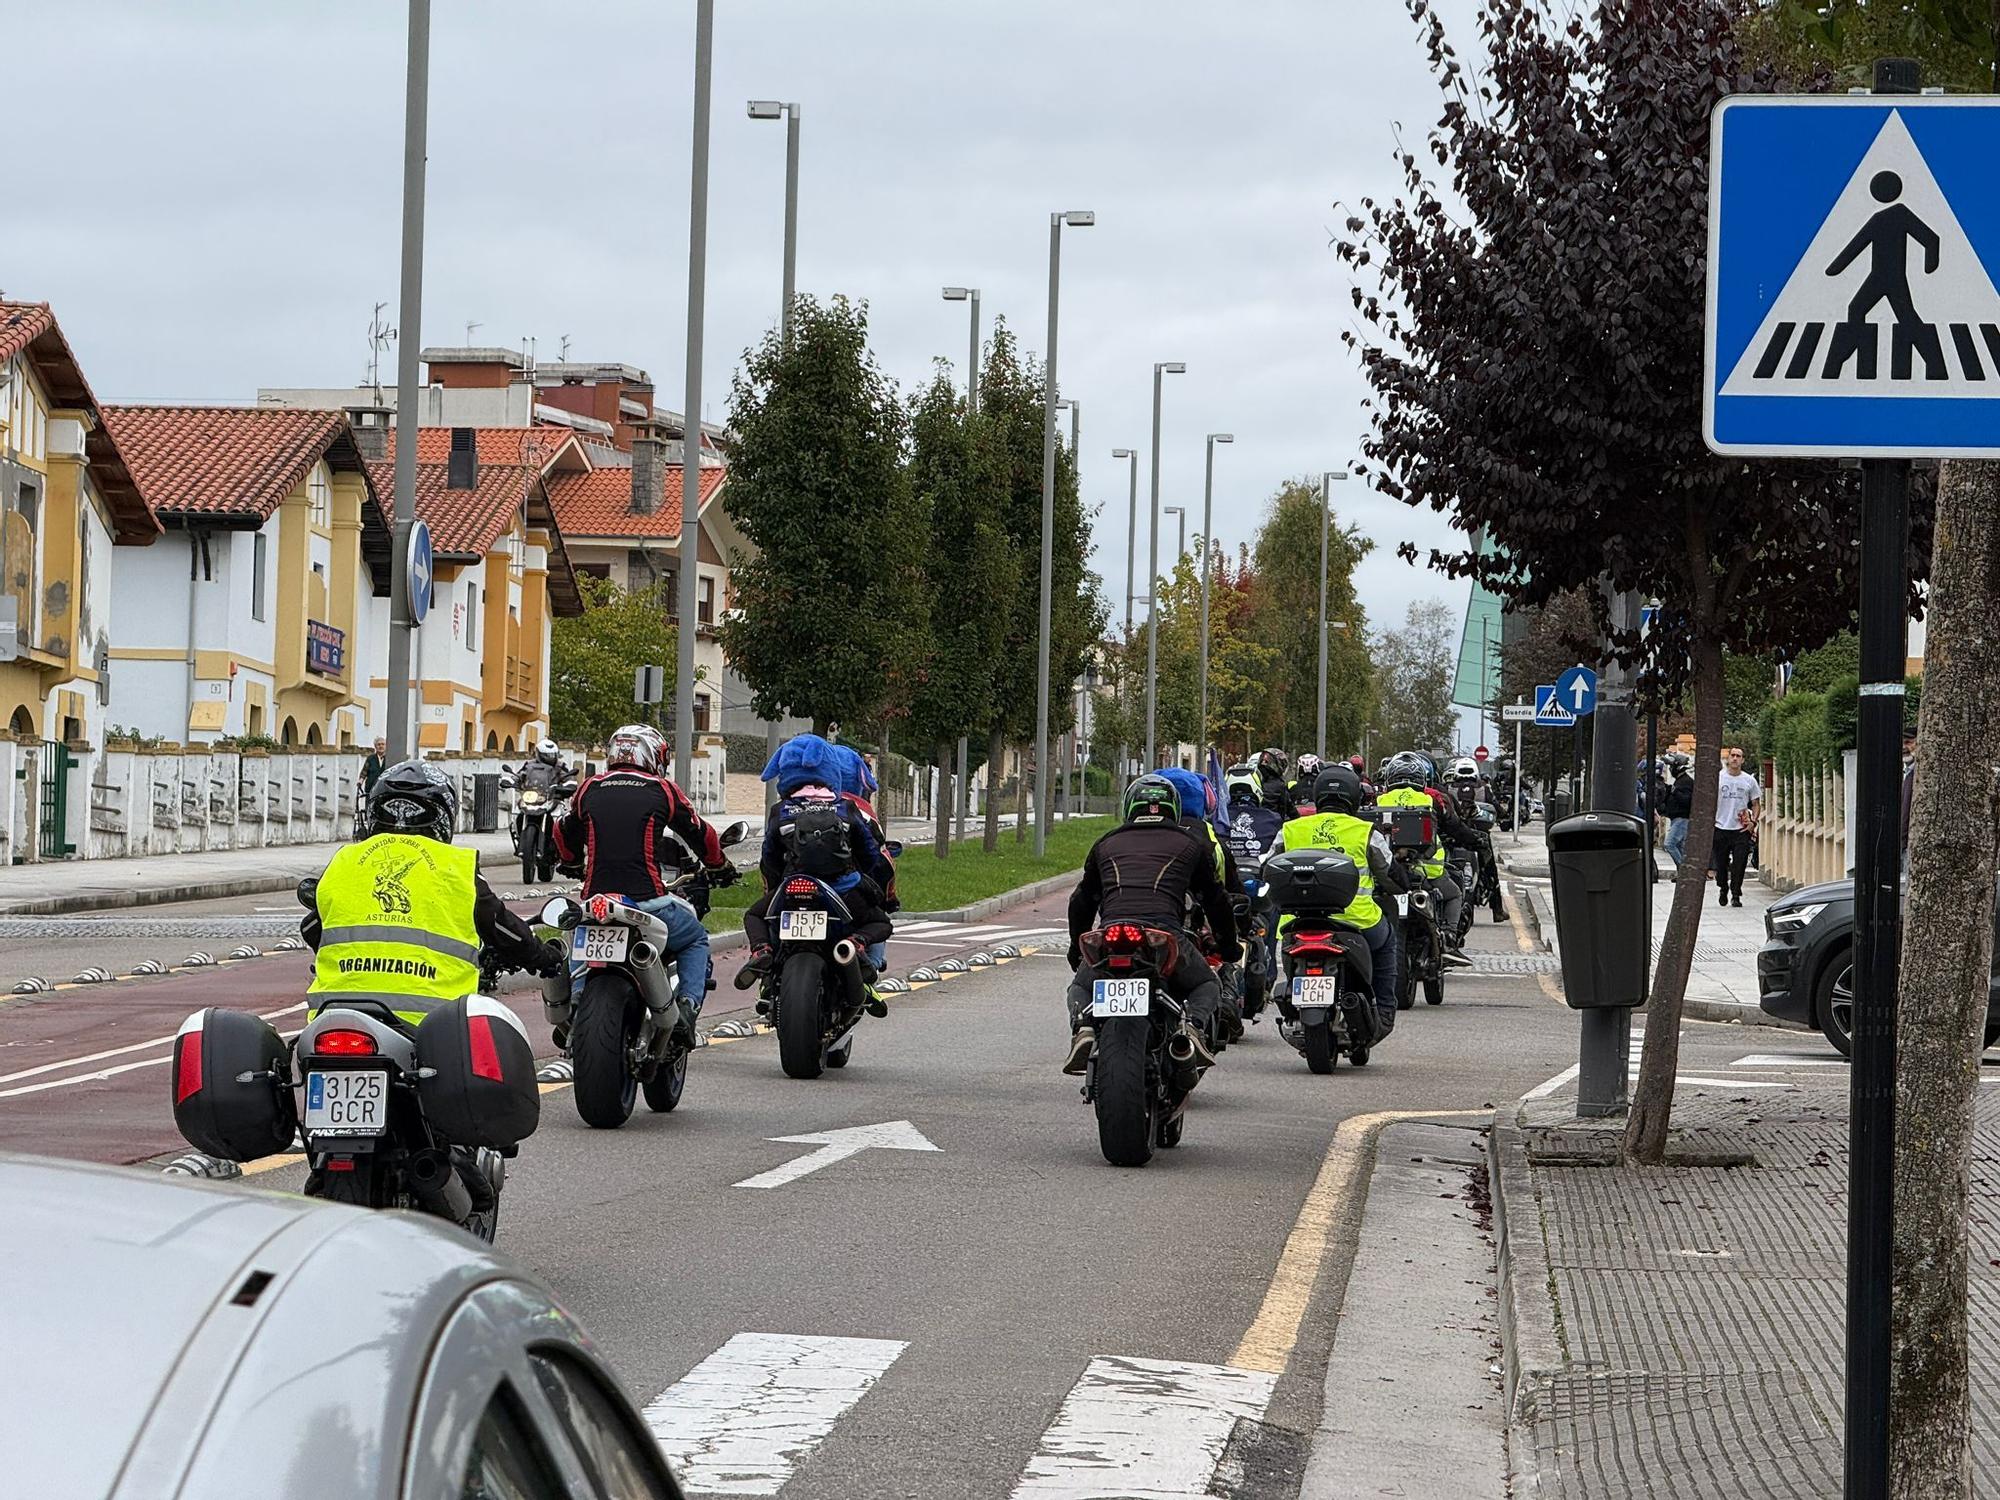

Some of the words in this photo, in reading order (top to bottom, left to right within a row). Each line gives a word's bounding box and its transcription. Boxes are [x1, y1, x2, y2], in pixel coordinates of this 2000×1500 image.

[358, 837, 397, 866] SOLIDARIDAD
[399, 837, 421, 849] SOBRE
[366, 913, 413, 924] ASTURIAS
[796, 913, 825, 925] 1515
[588, 929, 625, 943] 6524
[791, 926, 816, 937] DLY
[586, 944, 614, 959] GKG
[339, 958, 437, 980] ORGANIZACIÓN
[1108, 981, 1146, 996] 0816
[1303, 978, 1333, 990] 0245
[1302, 990, 1324, 1002] LCH
[1110, 998, 1138, 1013] GJK
[327, 1076, 380, 1099] 3125
[312, 1095, 320, 1104] E
[331, 1100, 375, 1123] GCR
